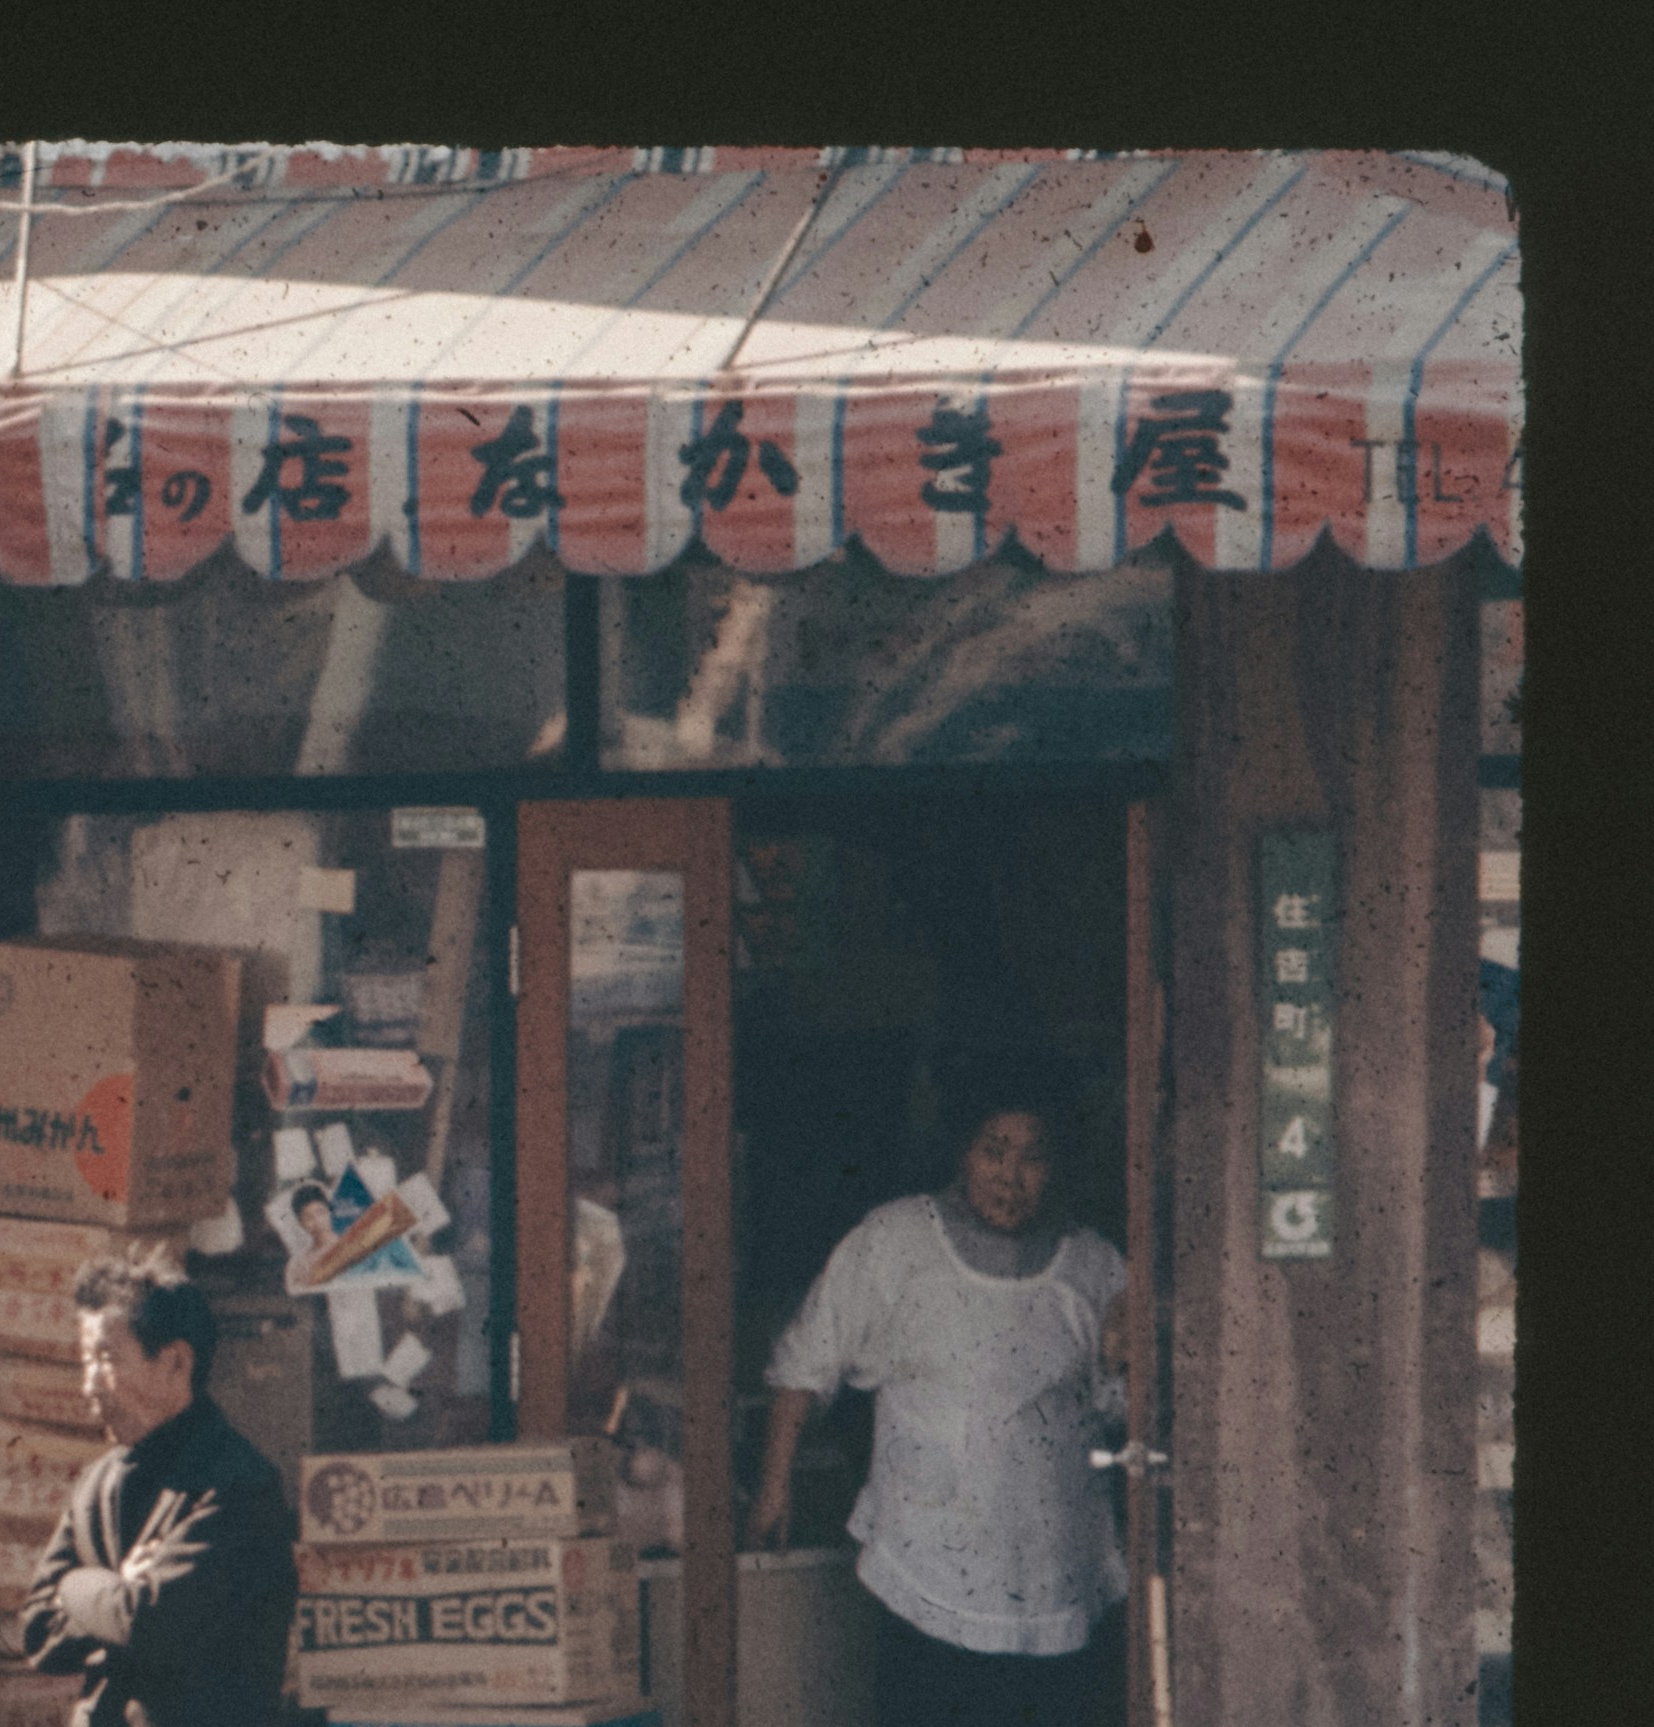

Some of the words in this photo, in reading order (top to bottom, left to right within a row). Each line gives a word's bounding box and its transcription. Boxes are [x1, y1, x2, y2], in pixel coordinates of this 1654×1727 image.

[1350, 438, 1464, 504] TEL
[1279, 1115, 1308, 1159] 4
[293, 1600, 419, 1648] FRESH
[431, 1592, 557, 1642] EGGS
